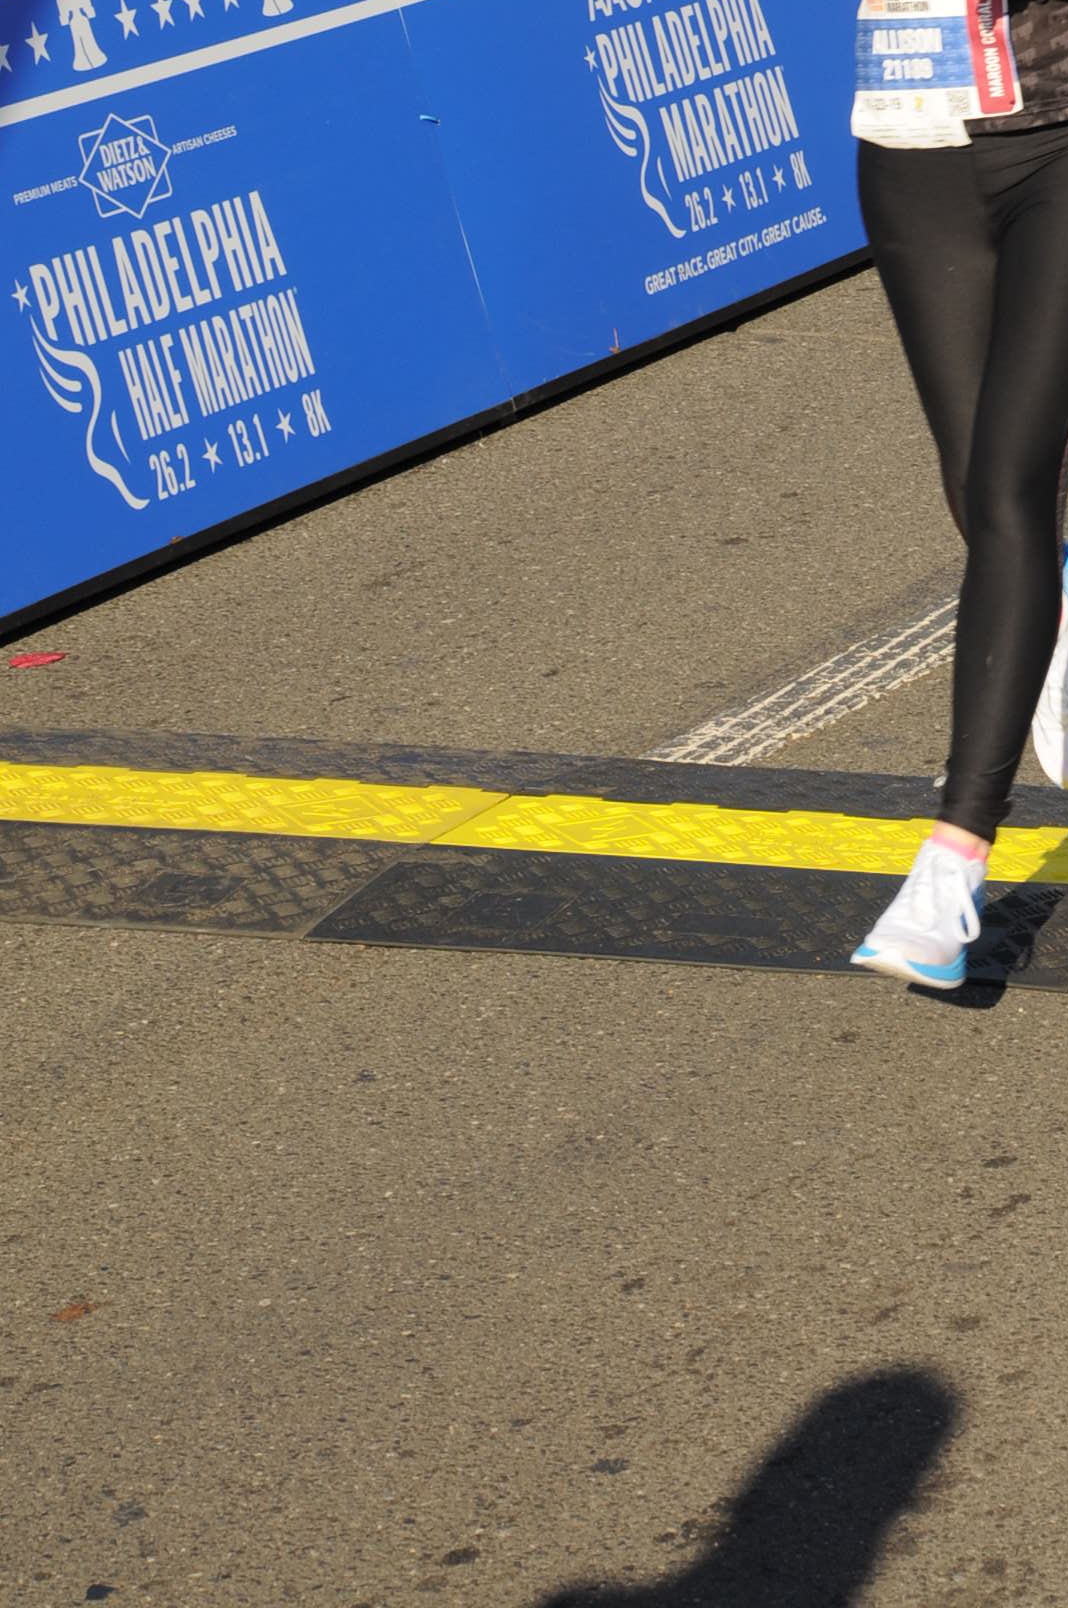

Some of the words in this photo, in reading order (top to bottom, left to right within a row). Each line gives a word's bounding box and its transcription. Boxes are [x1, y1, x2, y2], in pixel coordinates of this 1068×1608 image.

[978, 0, 997, 45] CORRAL
[984, 47, 1005, 99] MAROON
[100, 136, 136, 167] DIETZ
[172, 135, 204, 155] ARTISAN
[203, 125, 238, 145] CHEESES
[660, 66, 799, 183] MARATHON
[13, 184, 51, 205] PREMIUM
[50, 176, 78, 194] MEATS
[97, 156, 156, 193] WATSON
[684, 187, 718, 232] 26.2
[739, 167, 768, 210] 13.1
[790, 150, 812, 190] 8K
[29, 190, 287, 346] PHILADELPHIA
[645, 267, 676, 295] GREAT
[678, 256, 707, 282] RACE.
[707, 243, 737, 271] GREAT
[738, 233, 762, 257] CITY.
[762, 220, 791, 246] GREAT
[792, 207, 827, 236] CAUSE.
[118, 333, 190, 440] HALF
[179, 288, 316, 417] MARATHON
[149, 443, 196, 501] 26.2
[228, 413, 269, 467] 13.1
[302, 389, 331, 438] 8K
